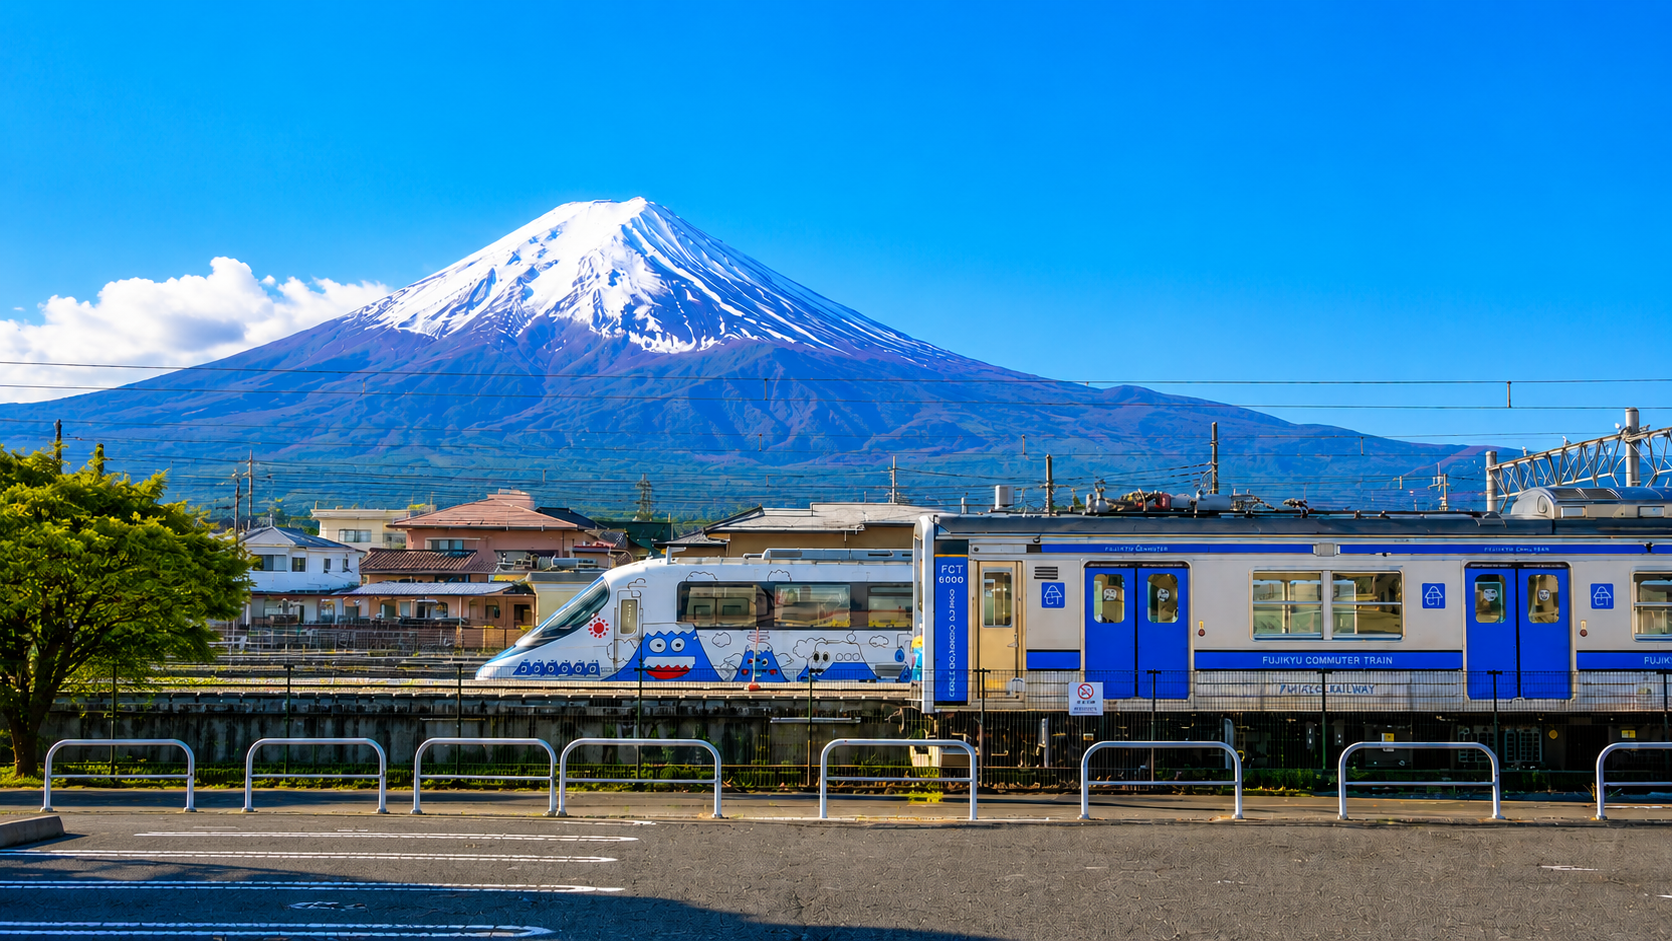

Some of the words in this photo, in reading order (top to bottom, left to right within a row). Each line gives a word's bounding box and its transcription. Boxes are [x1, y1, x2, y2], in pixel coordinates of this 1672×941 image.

[941, 564, 964, 574] FCT
[938, 575, 964, 584] 6000
[1262, 655, 1303, 665] FUJIKYU
[1305, 655, 1361, 665] COMMUTER
[1363, 655, 1393, 665] TRAIN
